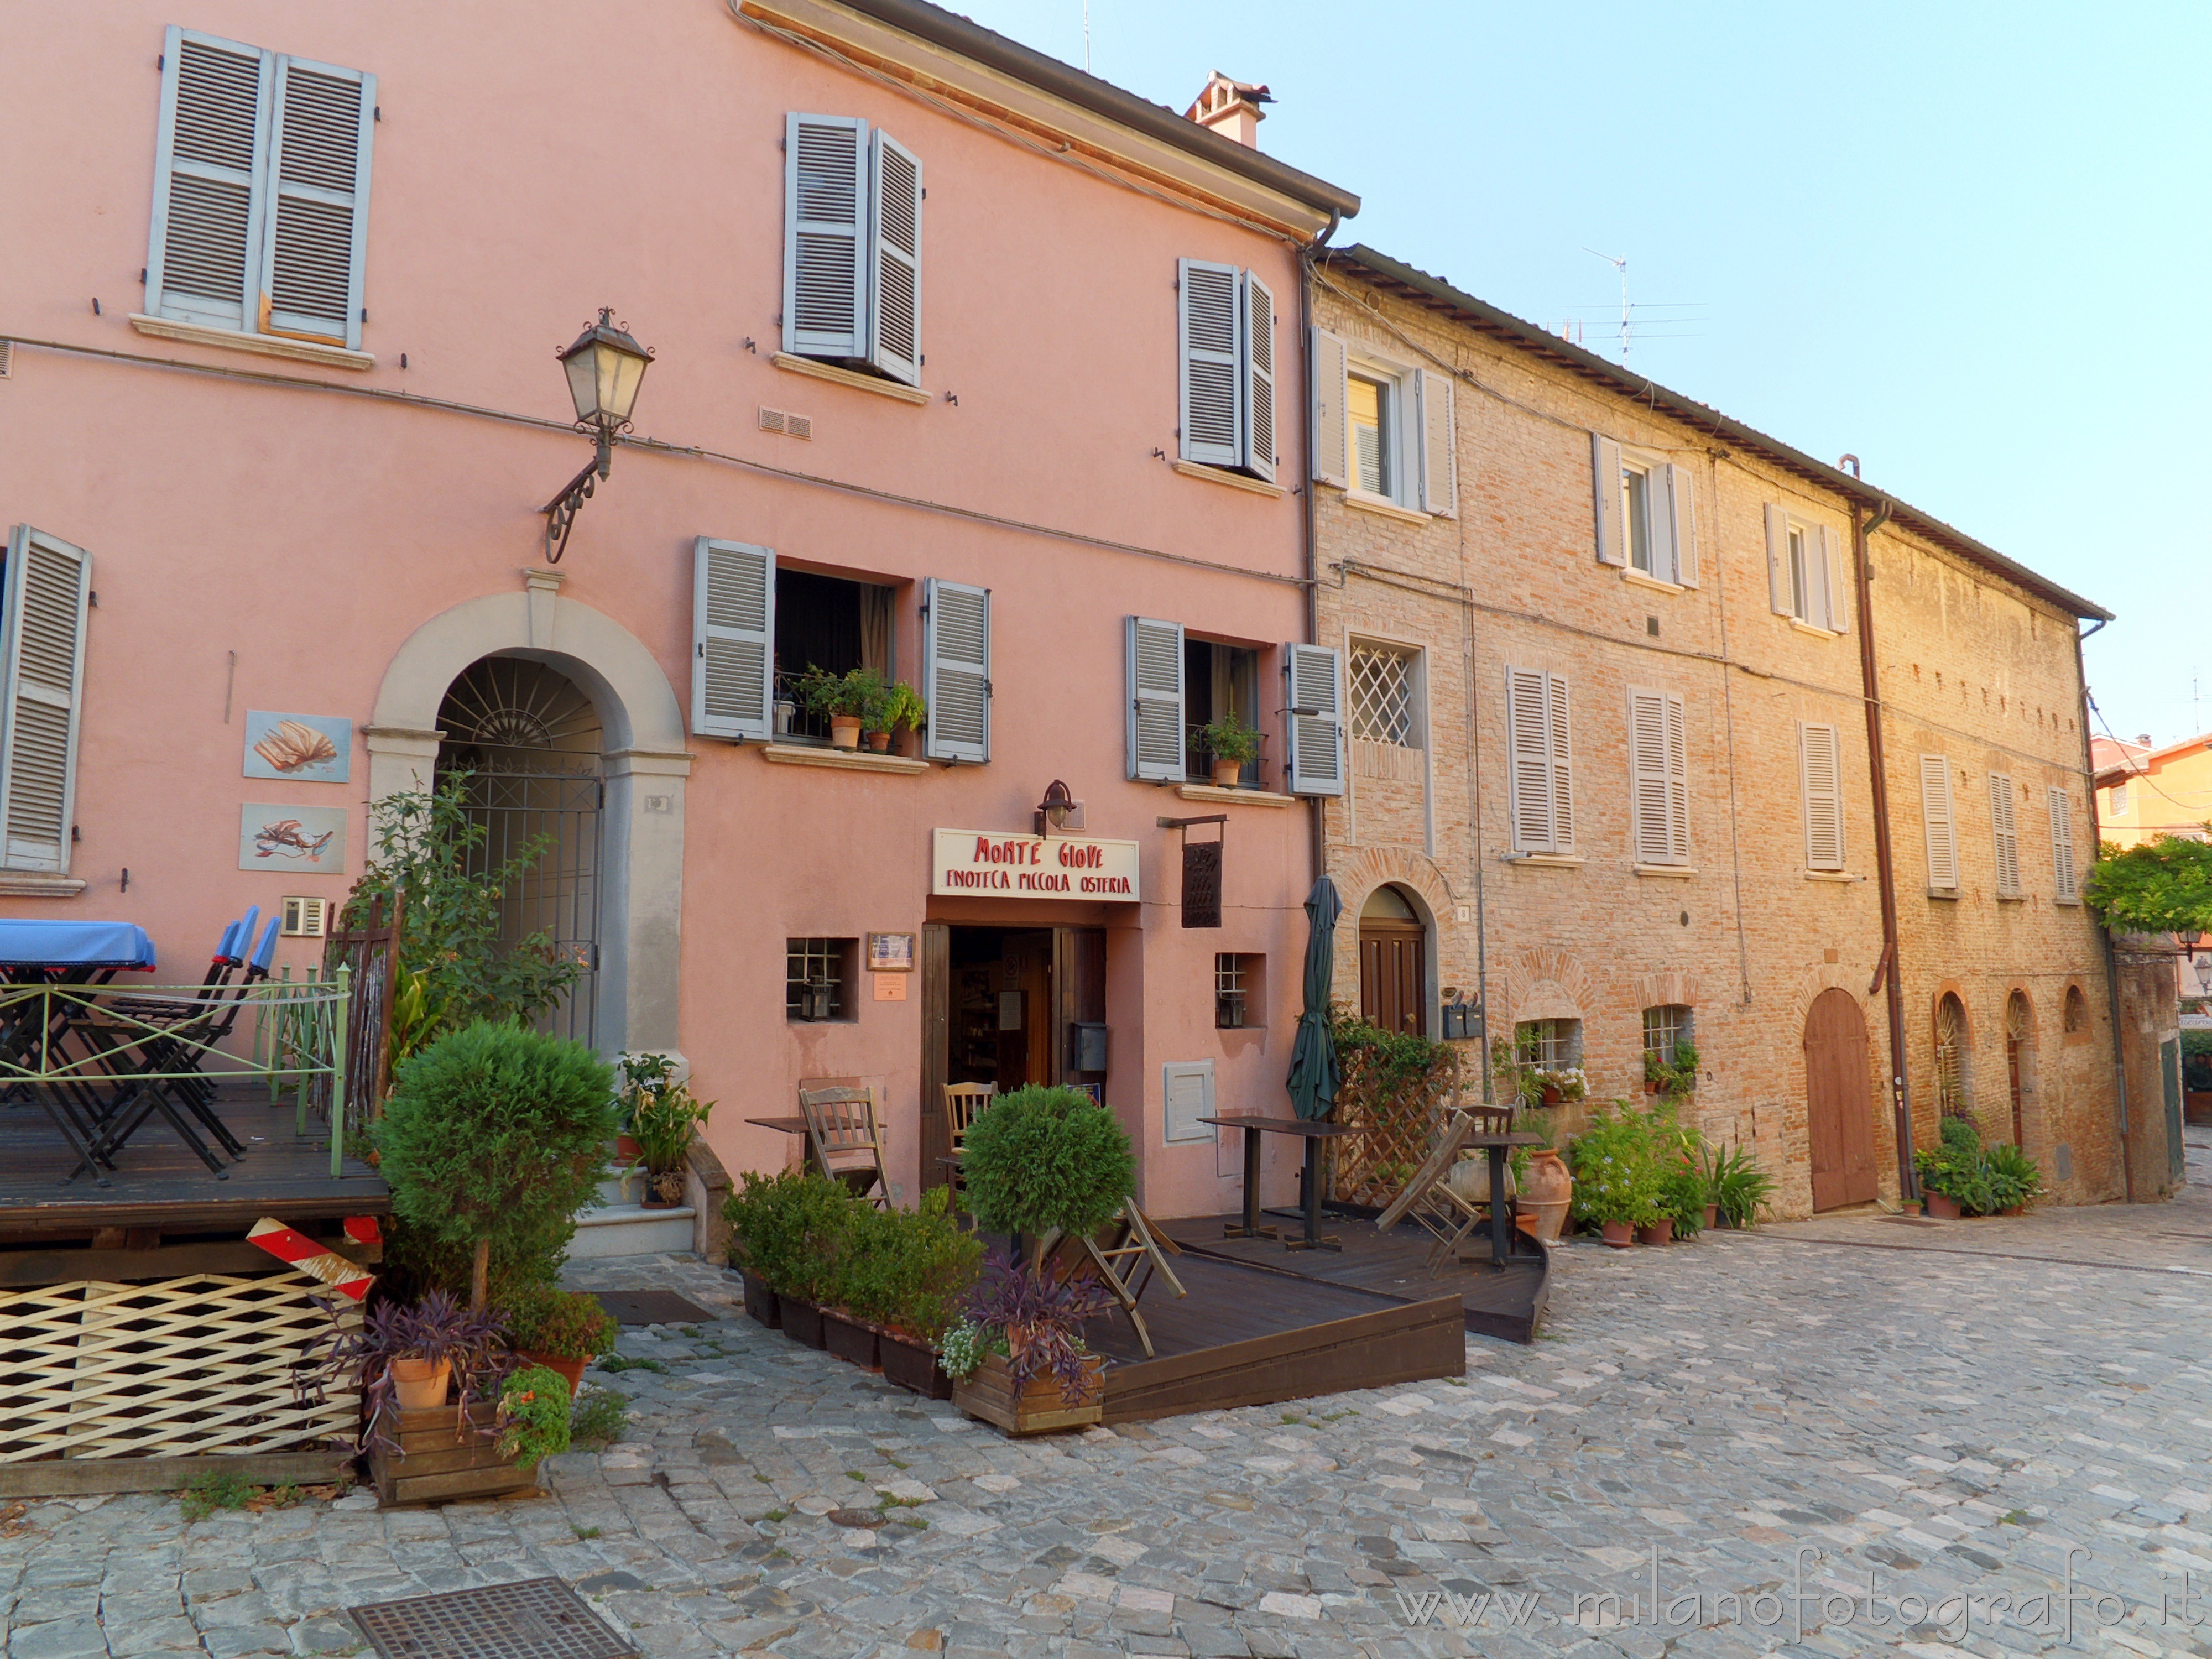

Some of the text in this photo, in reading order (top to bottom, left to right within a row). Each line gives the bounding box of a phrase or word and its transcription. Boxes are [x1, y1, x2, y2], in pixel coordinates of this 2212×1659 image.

[974, 836, 1104, 868] MONTE GIOVE
[947, 869, 1131, 894] ENOTECA PICCOLA OSTERIA
[1462, 909, 1466, 919] 8
